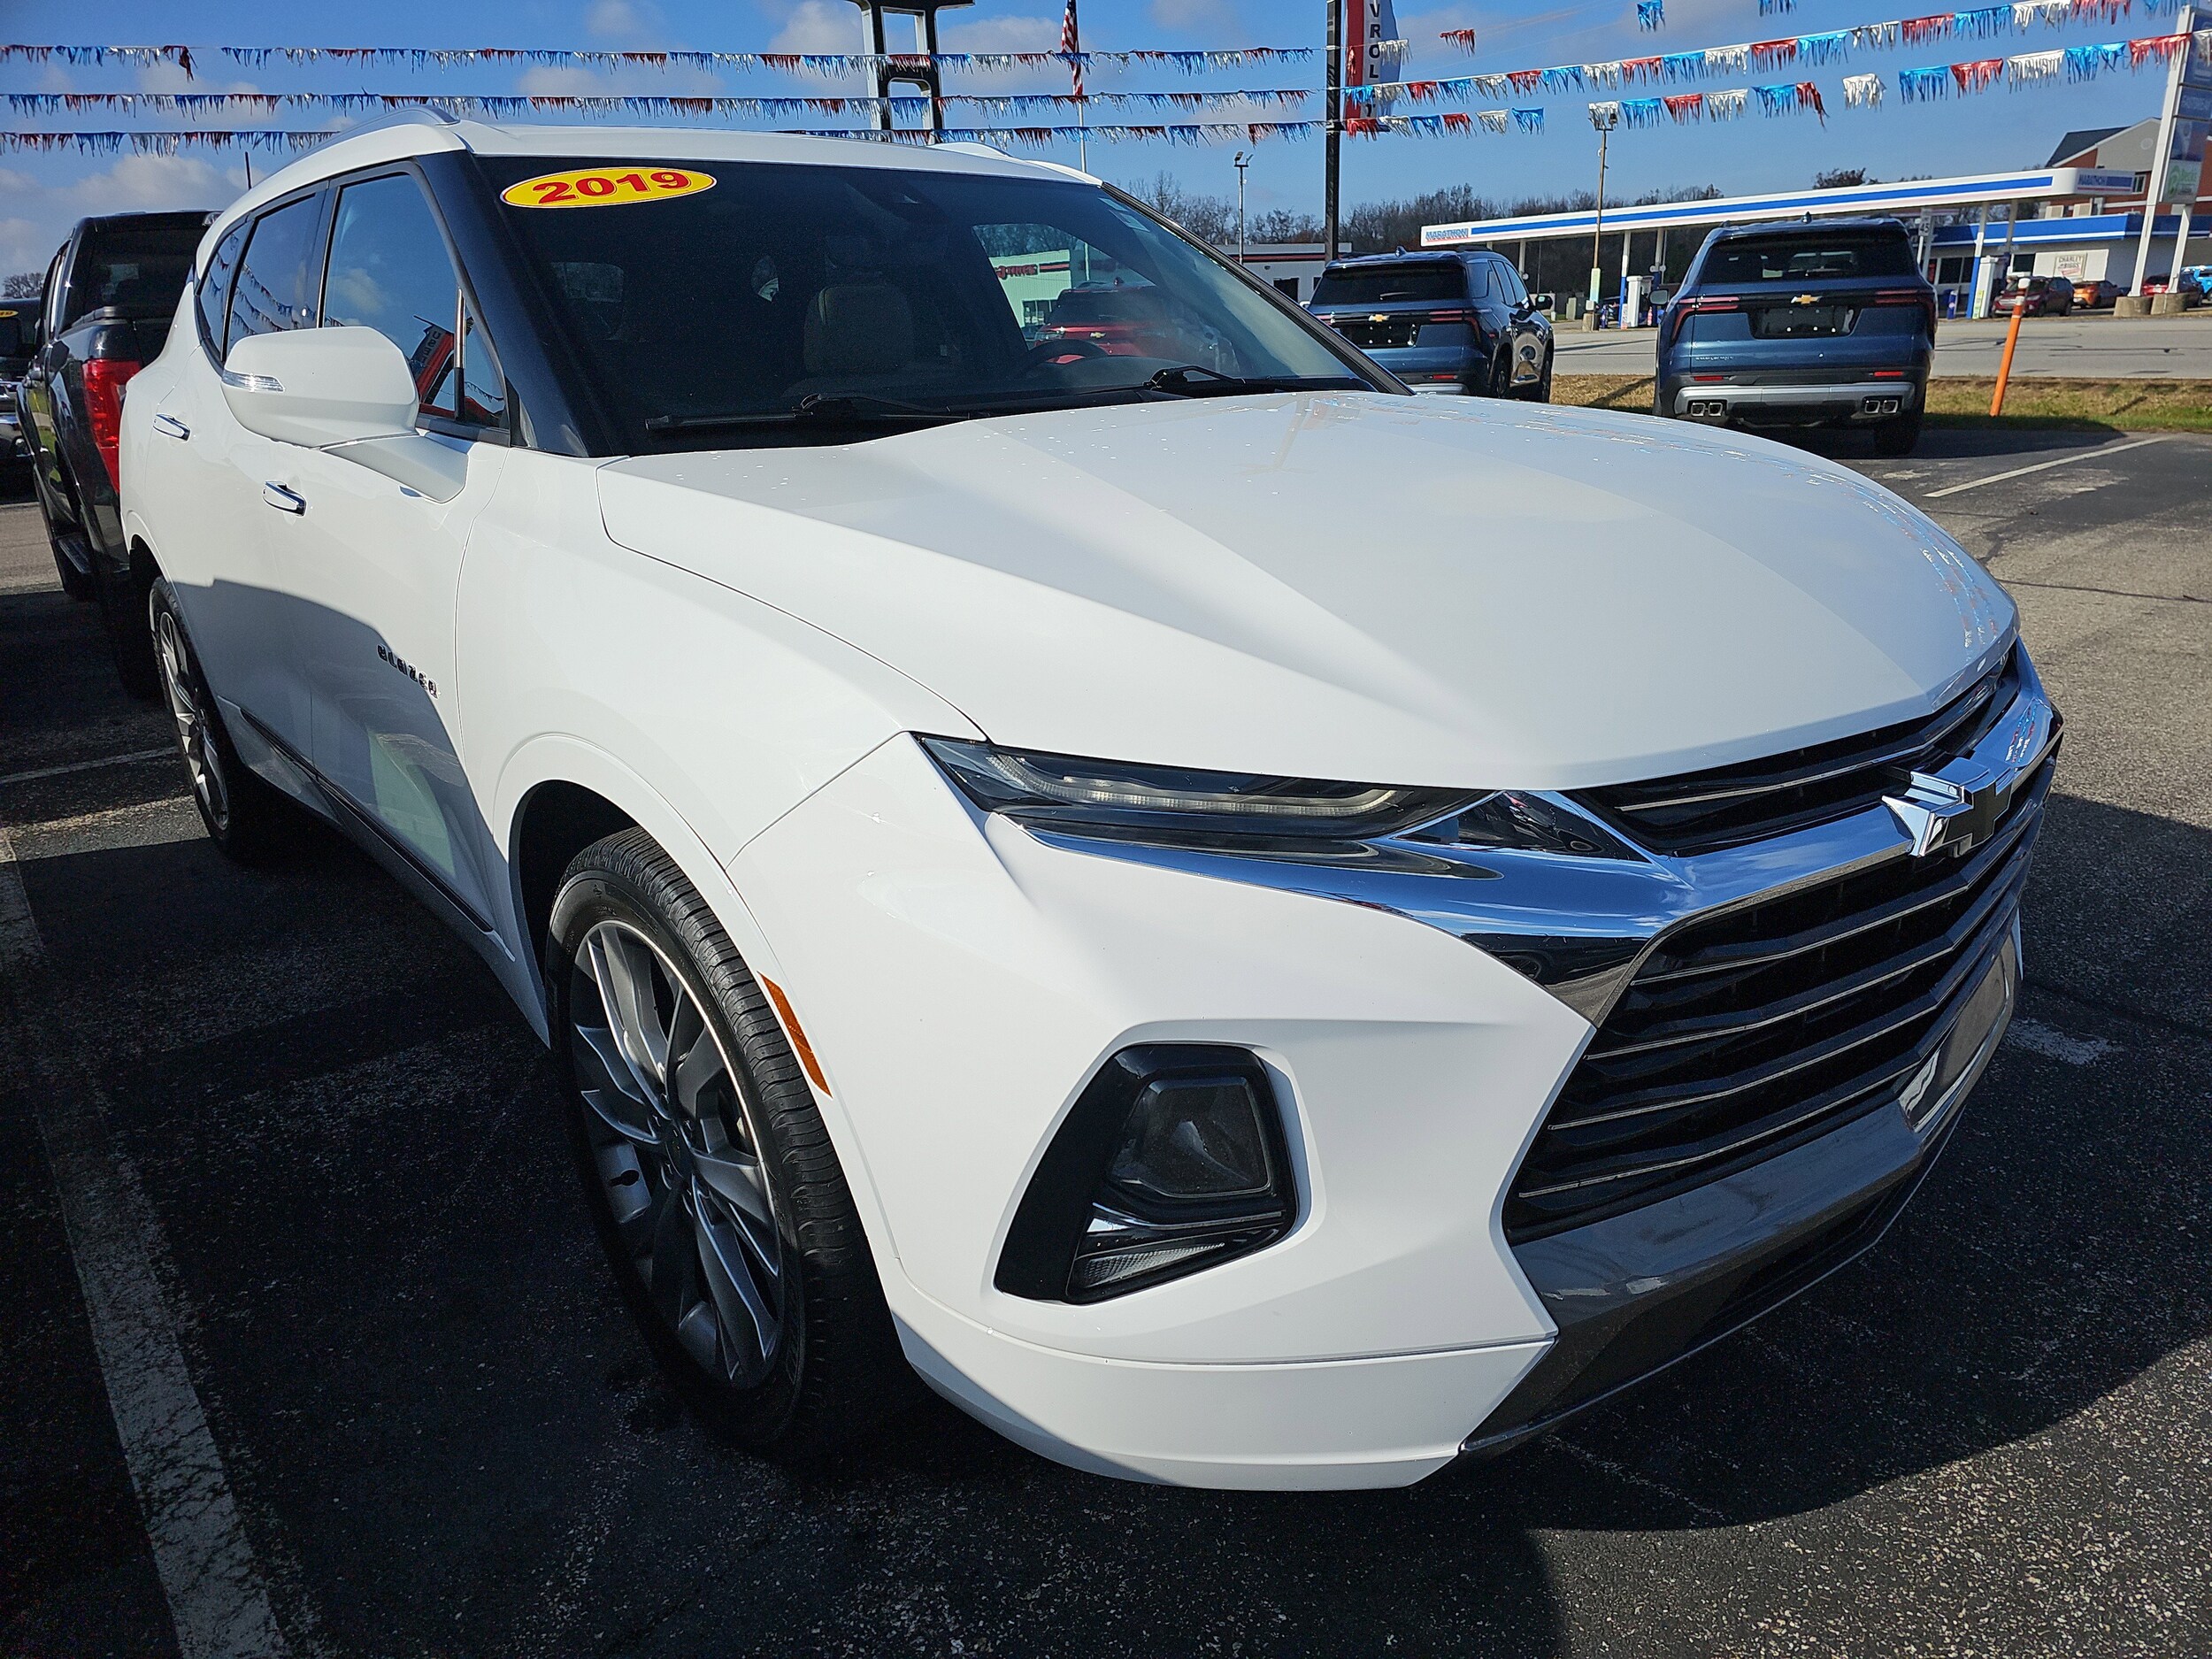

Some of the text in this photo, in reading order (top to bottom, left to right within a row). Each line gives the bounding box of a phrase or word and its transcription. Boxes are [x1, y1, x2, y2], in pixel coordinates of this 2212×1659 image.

[1369, 3, 1380, 118] VROLT
[533, 171, 692, 204] 2019
[1425, 228, 1469, 241] MARATHON
[1920, 222, 1930, 234] 45
[377, 644, 439, 699] BLAZER
